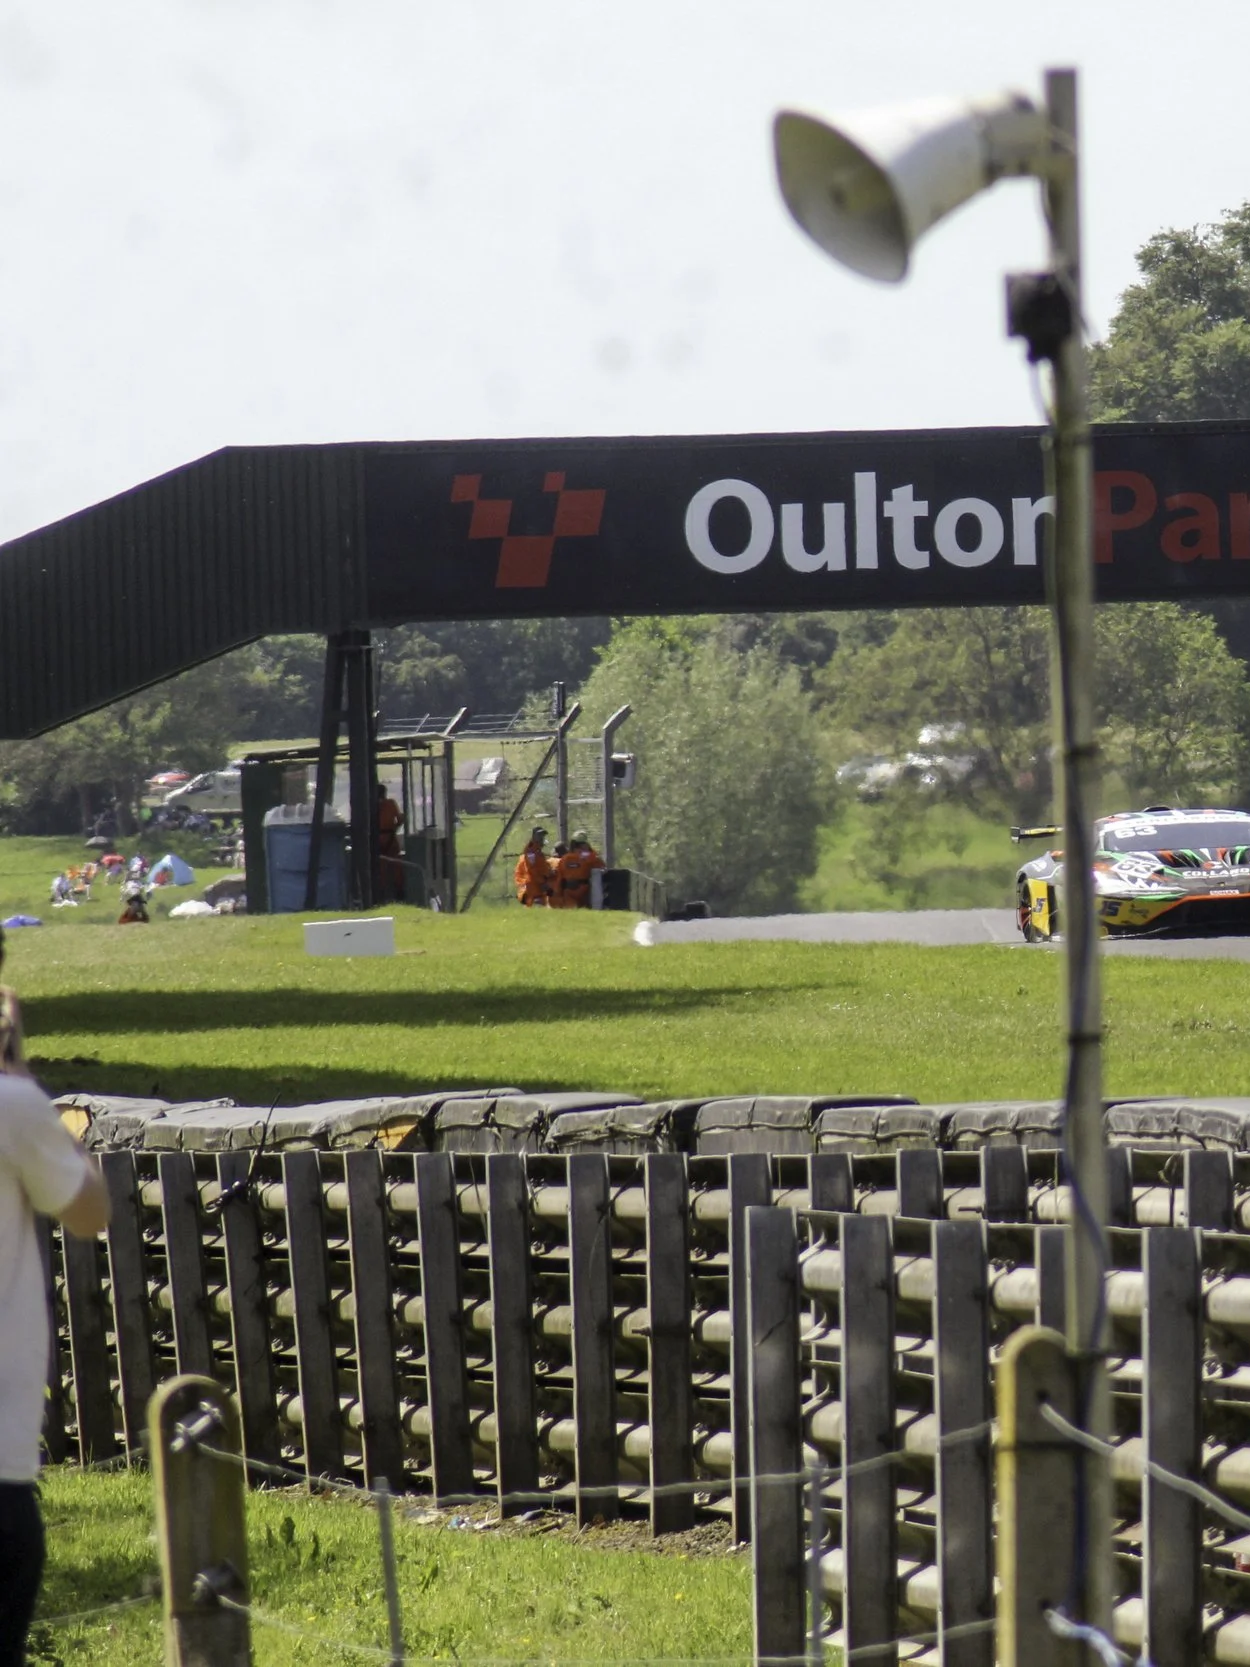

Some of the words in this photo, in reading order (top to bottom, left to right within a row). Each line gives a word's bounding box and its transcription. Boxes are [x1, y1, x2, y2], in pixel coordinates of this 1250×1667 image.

[1114, 825, 1157, 839] 63
[1117, 859, 1156, 874] 63
[1182, 867, 1250, 878] COLLARD
